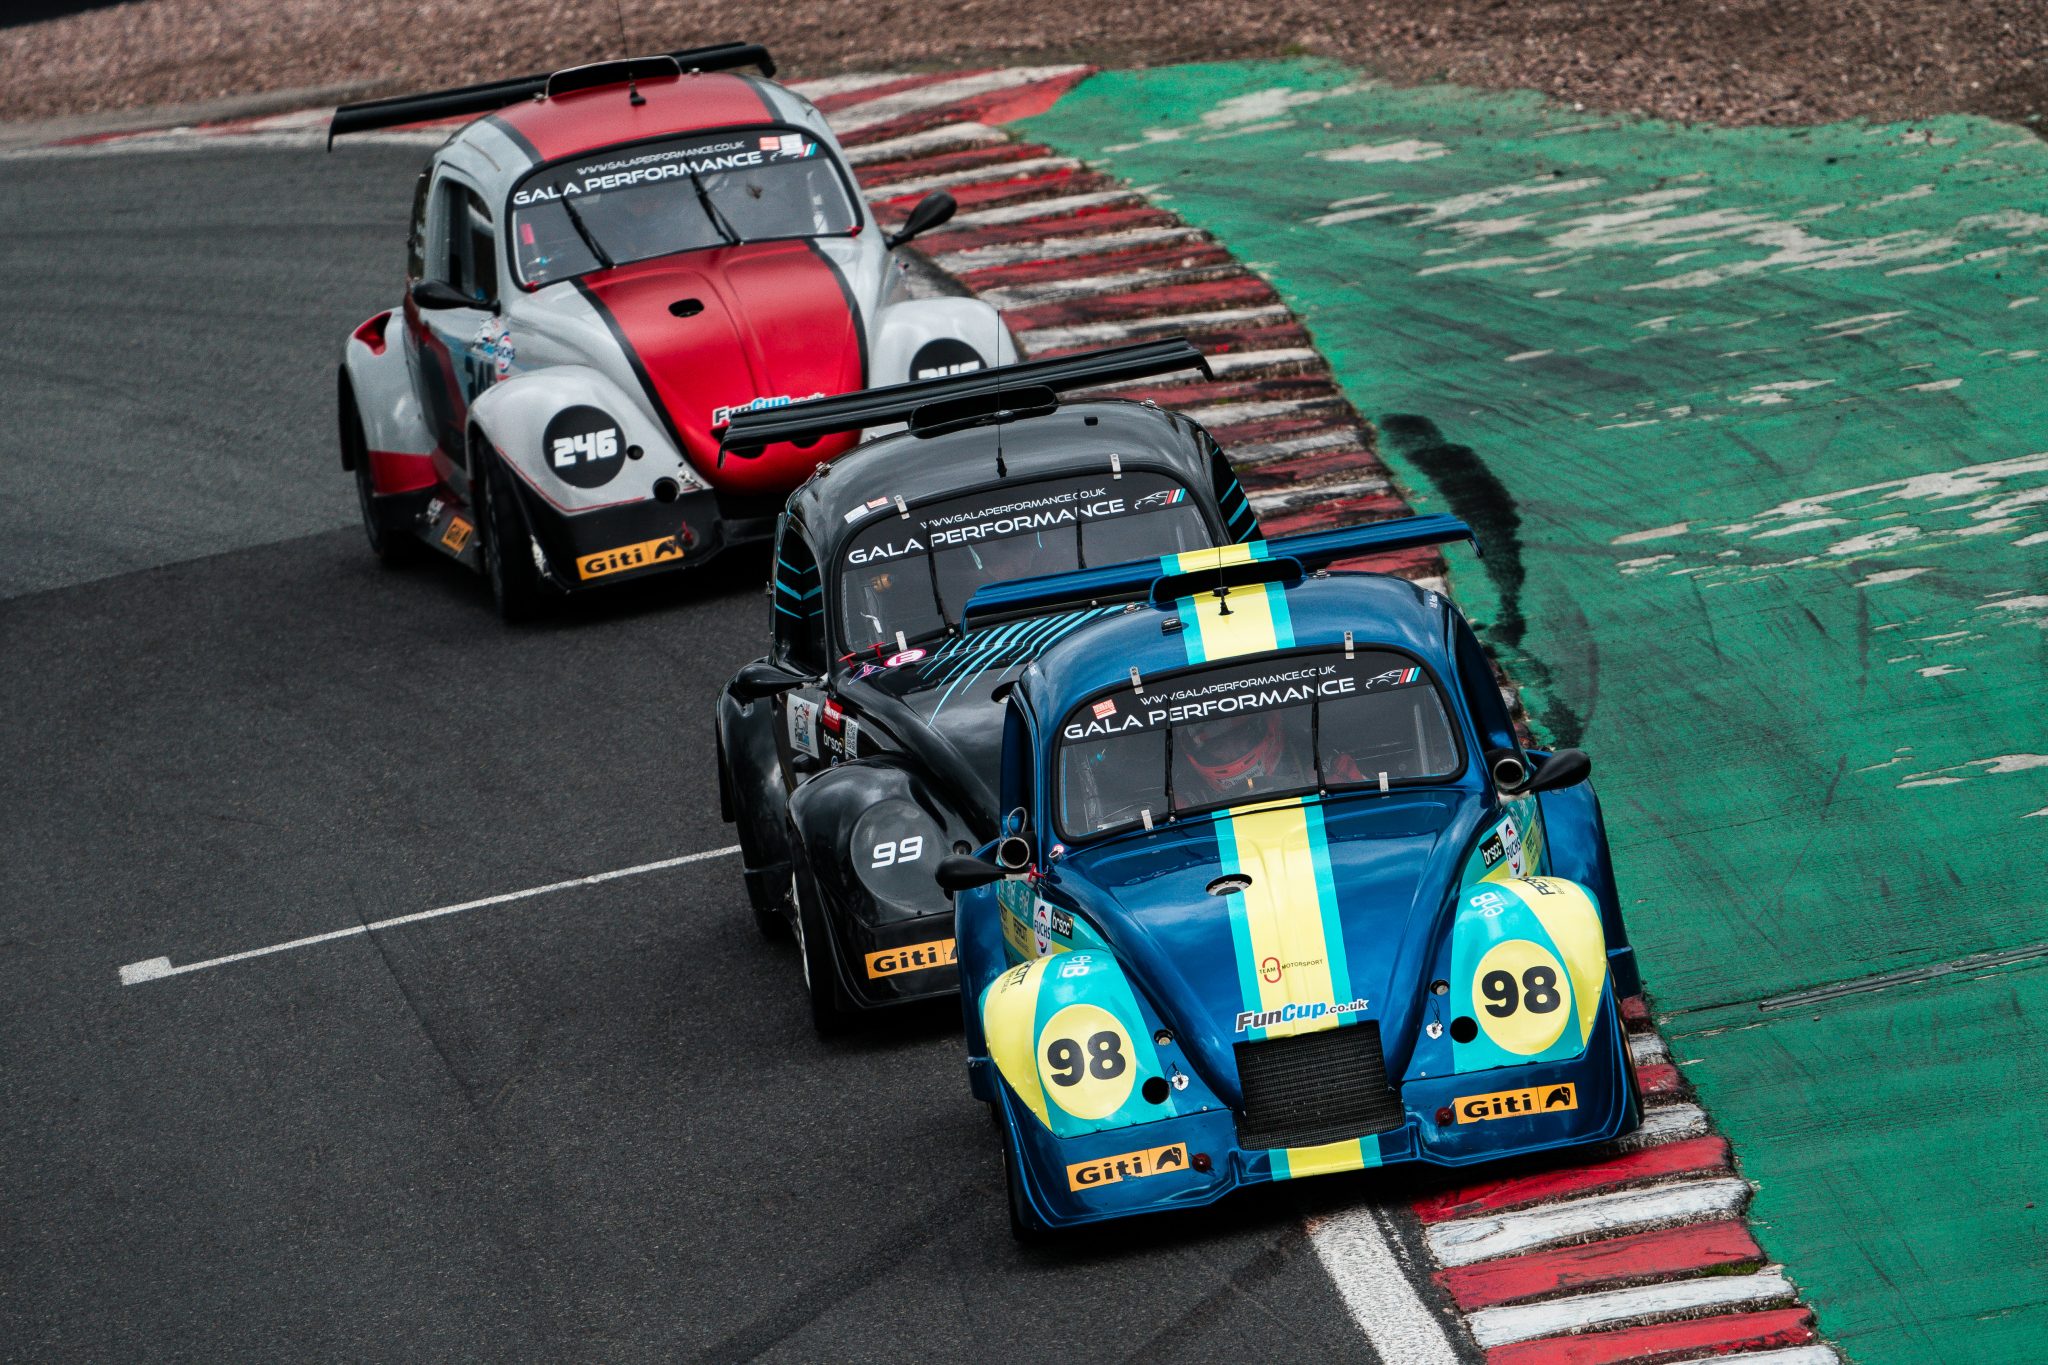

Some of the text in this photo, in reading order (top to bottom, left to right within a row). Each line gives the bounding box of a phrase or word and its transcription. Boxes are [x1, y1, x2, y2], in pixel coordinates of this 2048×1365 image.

[576, 140, 745, 176] WWW.GALAPERFORMANCE.CO.UK
[512, 150, 763, 205] GALA PERFORMANCE
[553, 427, 617, 468] 246
[919, 487, 1107, 529] WWW.GALAPERFORMANCE.CO.UK
[847, 498, 1126, 564] GALA PERFORMANCE
[584, 548, 643, 574] Giti
[1063, 714, 1144, 739] GALA
[1148, 677, 1356, 726] PERFORMANCE
[871, 835, 923, 869] 99
[1481, 841, 1502, 865] brscc
[1506, 836, 1521, 861] FUCHS
[1033, 919, 1051, 940] FUCHS
[1051, 911, 1071, 936] brscc
[873, 946, 938, 973] Giti
[1259, 966, 1277, 975] TEAM
[1281, 958, 1324, 970] MOTORSPORT
[1481, 964, 1561, 1018] 98
[1236, 999, 1368, 1032] FunCup.co.uk
[1046, 1030, 1127, 1087] 98
[1463, 1093, 1533, 1119] Giti
[1075, 1156, 1143, 1185] Giti
